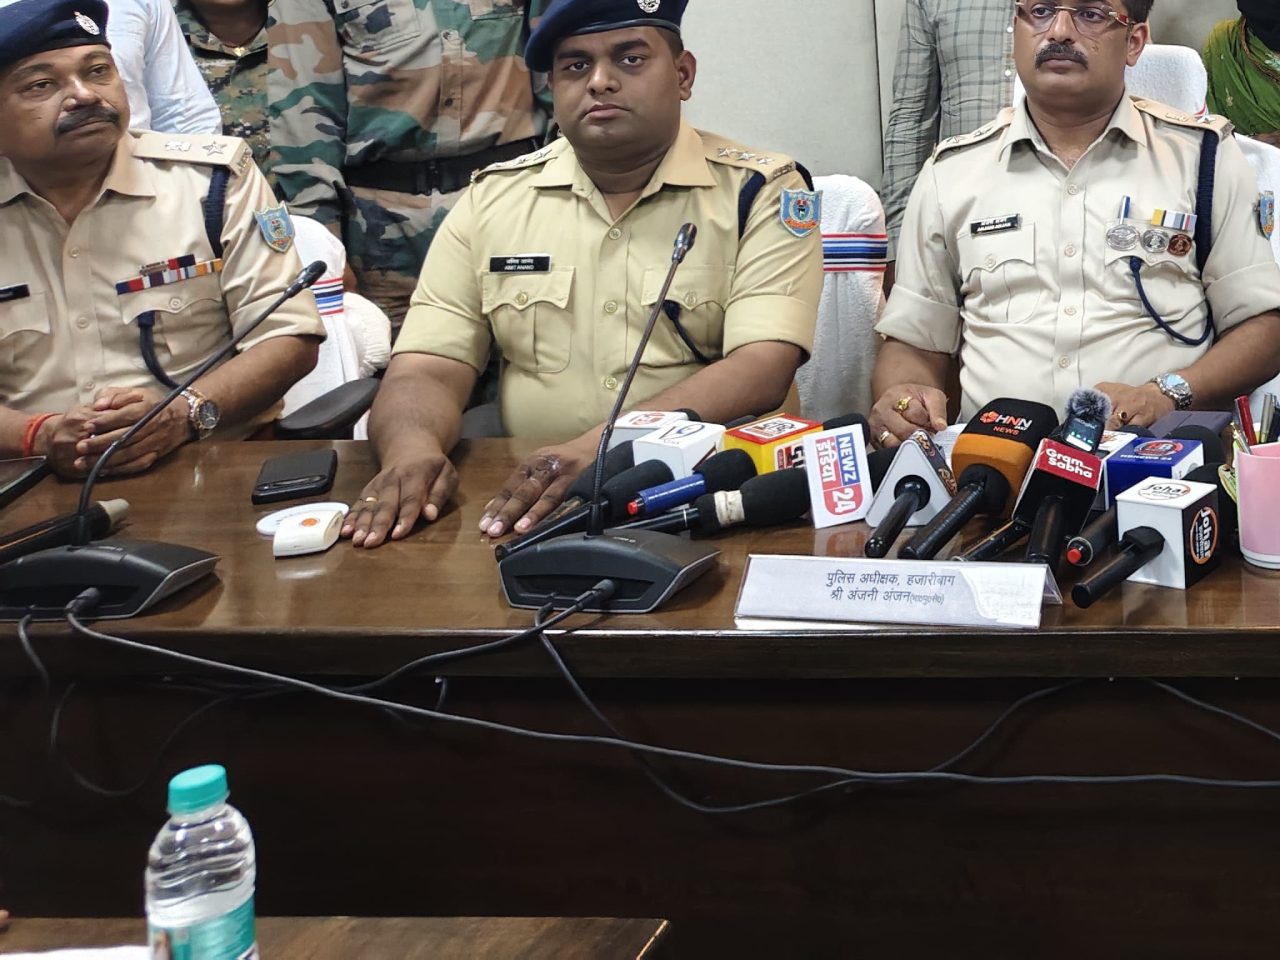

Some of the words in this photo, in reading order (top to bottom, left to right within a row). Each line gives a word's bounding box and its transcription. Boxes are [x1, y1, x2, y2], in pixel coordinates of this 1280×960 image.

[993, 426, 1020, 436] NEWS
[995, 414, 1033, 428] HNN
[815, 439, 836, 483] इंडिया
[838, 435, 857, 483] NEWZ
[1046, 448, 1089, 469] Gram
[1048, 456, 1093, 479] Sabha
[832, 487, 857, 514] 24
[826, 569, 856, 587] पुलिस
[830, 586, 844, 601] श्री
[847, 587, 878, 601] अंजनी
